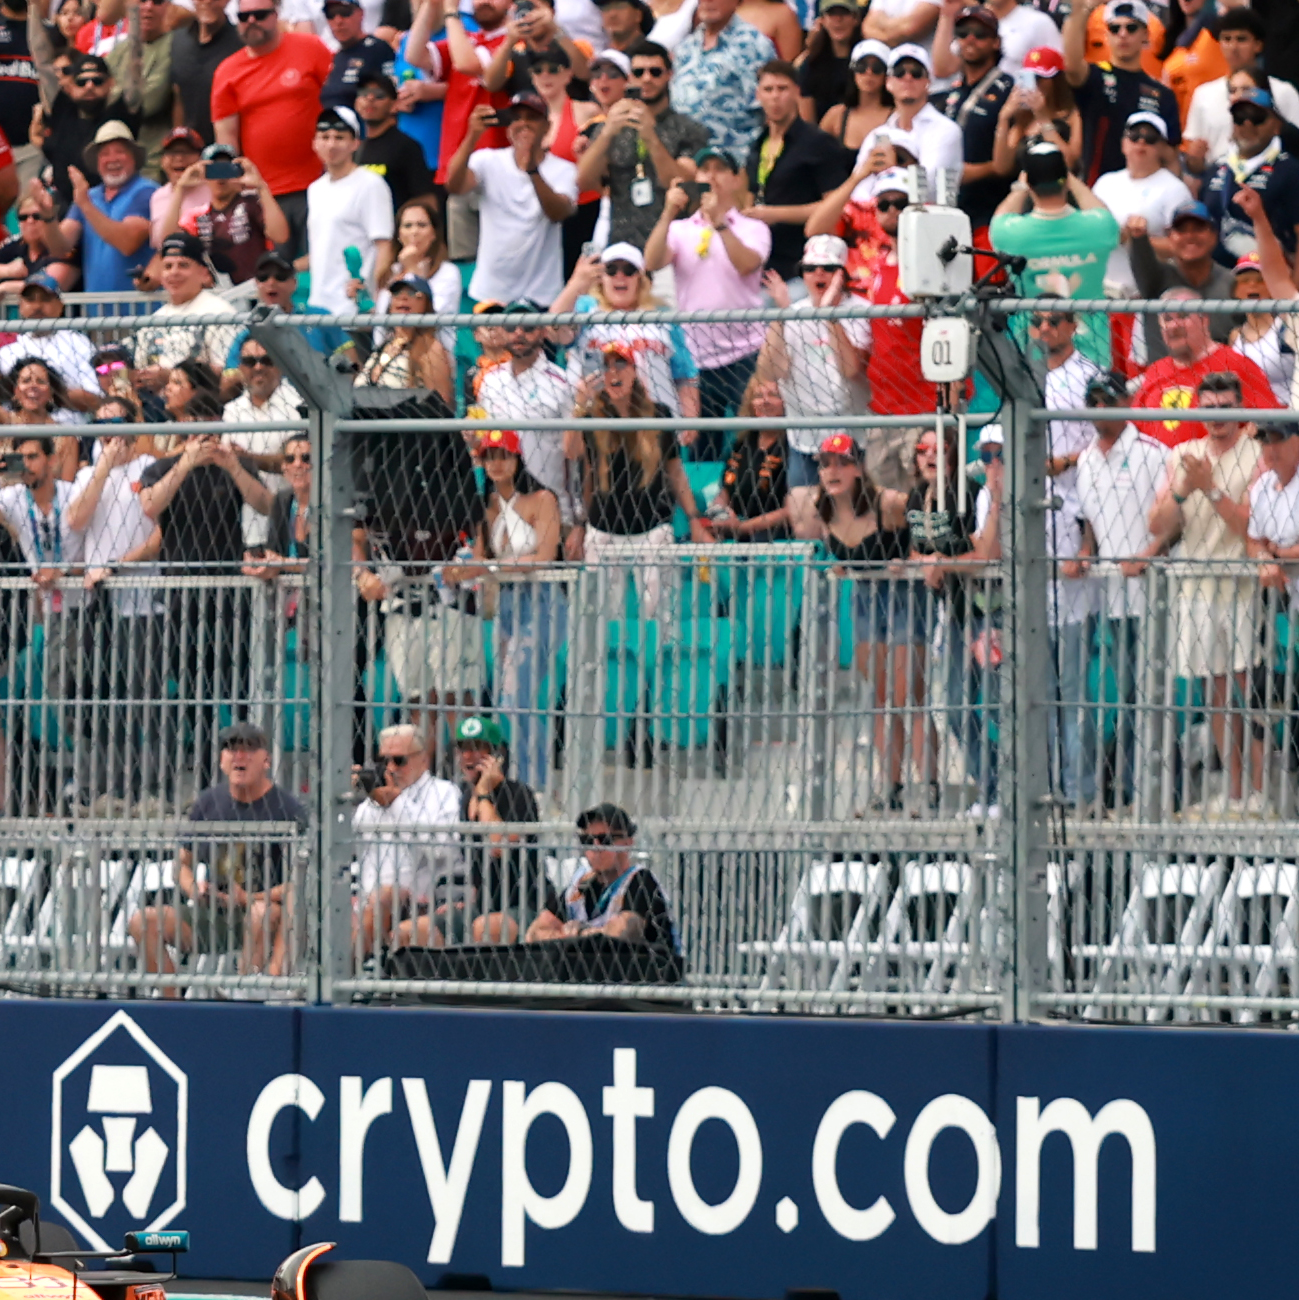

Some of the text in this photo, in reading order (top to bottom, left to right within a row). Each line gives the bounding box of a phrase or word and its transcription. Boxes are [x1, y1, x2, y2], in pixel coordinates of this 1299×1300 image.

[1024, 252, 1098, 271] ORMULA
[931, 340, 952, 366] 01
[247, 1048, 1157, 1267] crypto.com
[145, 1234, 181, 1247] allwyn
